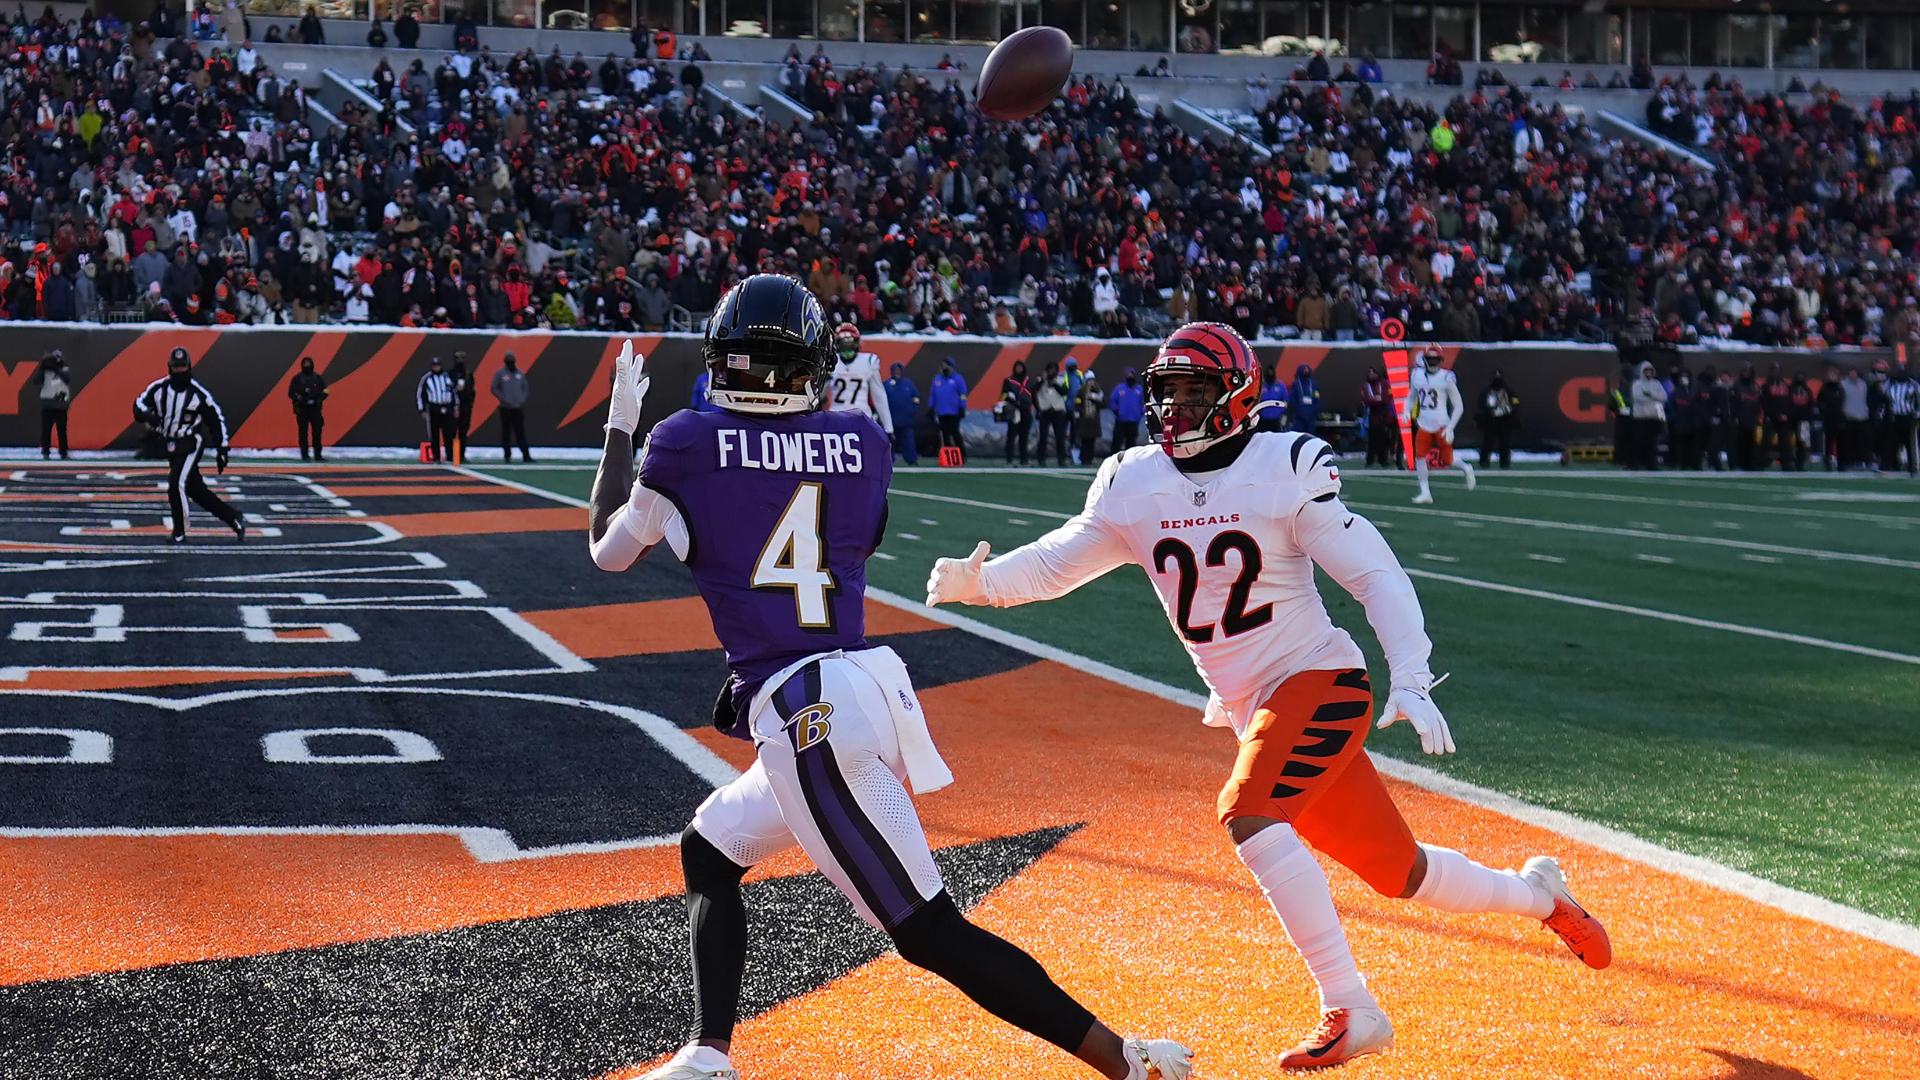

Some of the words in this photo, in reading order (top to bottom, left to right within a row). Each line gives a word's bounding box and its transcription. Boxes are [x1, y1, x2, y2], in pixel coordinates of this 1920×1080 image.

[763, 370, 776, 388] 4
[834, 378, 862, 404] 27
[1418, 387, 1439, 410] 23
[1558, 376, 1606, 423] C
[717, 429, 862, 473] FLOWERS
[943, 448, 961, 465] 10
[1160, 513, 1241, 529] BENGALS
[750, 481, 836, 628] 4
[1152, 529, 1274, 644] 22
[781, 702, 834, 752] B
